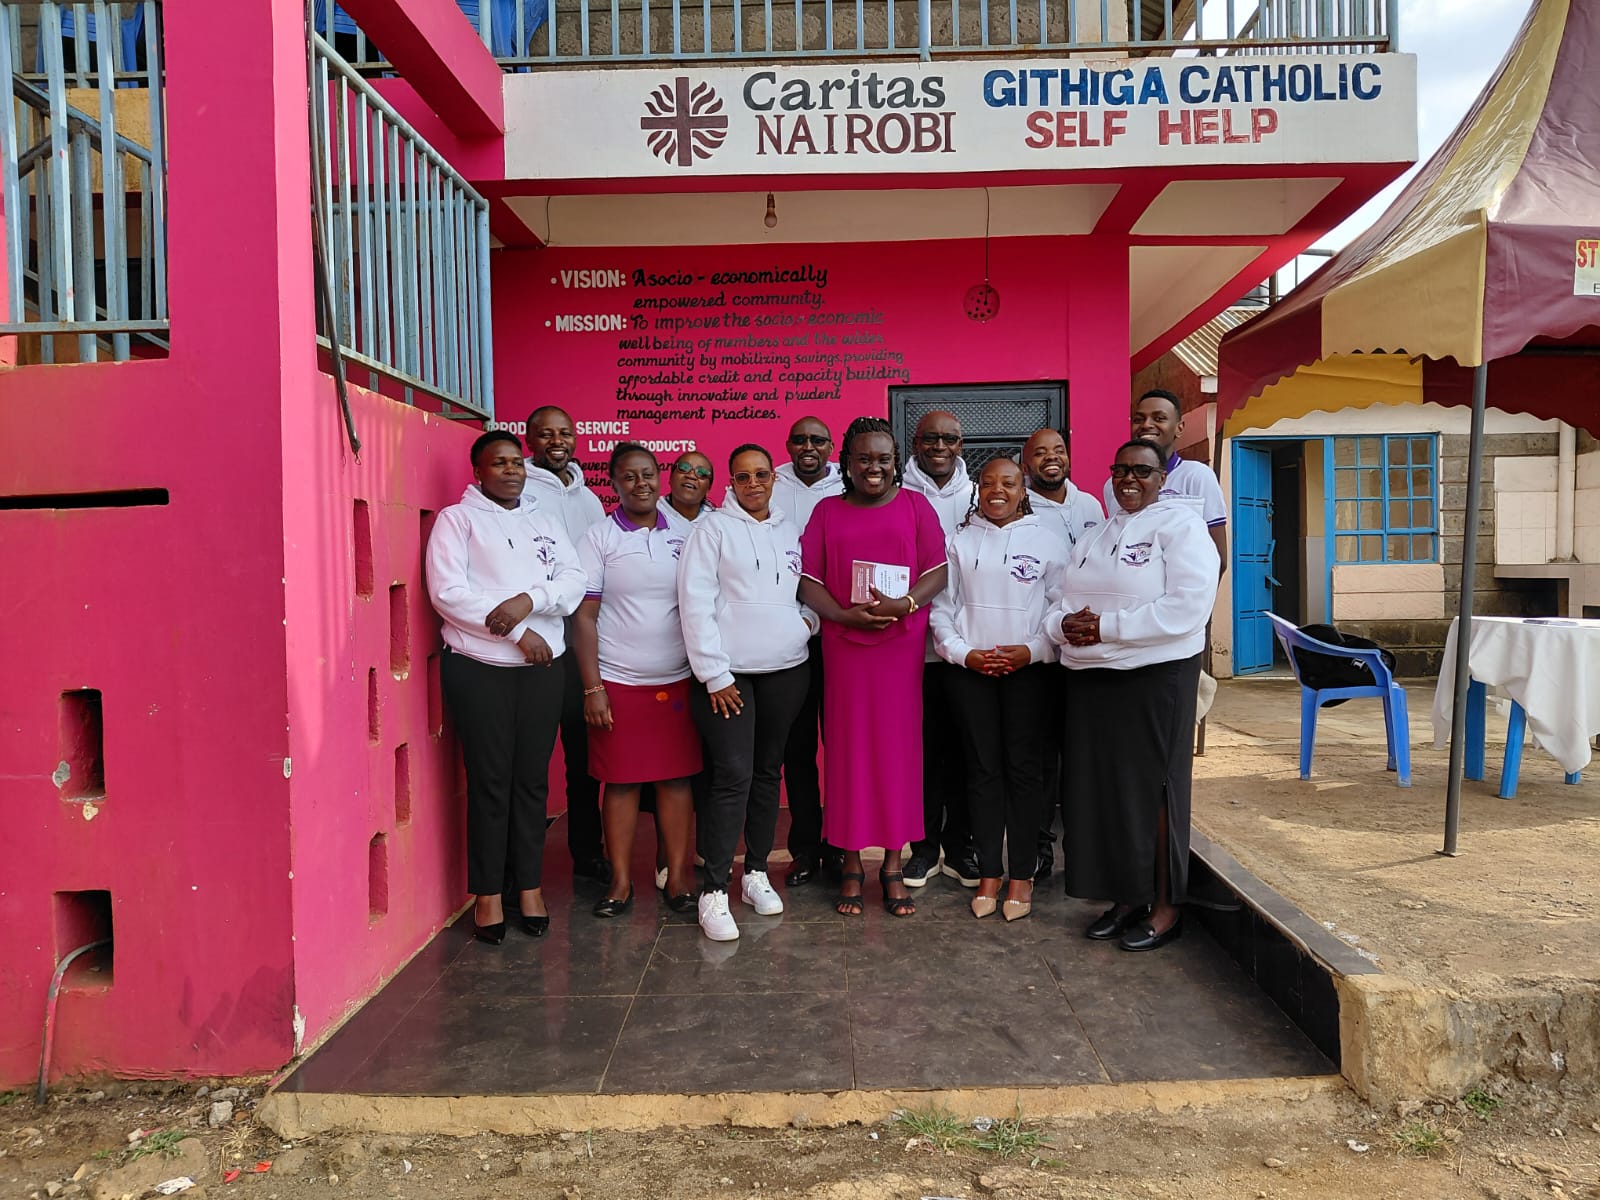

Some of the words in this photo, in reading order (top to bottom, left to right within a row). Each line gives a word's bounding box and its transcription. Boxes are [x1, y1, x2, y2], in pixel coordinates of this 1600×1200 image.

[743, 68, 946, 111] Caritas
[983, 66, 1169, 107] GITHIGA
[1179, 62, 1382, 104] CATHOLIC
[755, 112, 957, 155] NAIROBI
[1024, 110, 1128, 149] SELF
[1158, 108, 1278, 145] HELP
[560, 269, 627, 289] VISION:
[633, 291, 726, 312] empowered
[555, 314, 627, 332] MISSION:
[630, 314, 648, 330] To
[655, 314, 720, 333] improve
[723, 313, 750, 328] the
[698, 338, 712, 352] of
[715, 333, 779, 349] members
[782, 332, 808, 347] and
[814, 332, 837, 345] the
[842, 331, 883, 344] wider
[617, 353, 695, 371] community
[700, 354, 716, 370] by
[721, 351, 790, 369] mobilizing
[843, 349, 904, 368] providing
[618, 371, 693, 389] affordable
[698, 370, 739, 383] credit
[744, 369, 772, 382] and
[778, 368, 842, 388] capacity
[846, 365, 910, 383] building
[616, 388, 673, 406] through
[678, 388, 748, 401] innovative
[753, 387, 778, 401] and
[785, 386, 841, 408] prudent
[617, 406, 705, 424] management
[712, 406, 781, 424] practices.
[576, 421, 629, 435] SERVICE
[589, 440, 620, 452] LOA
